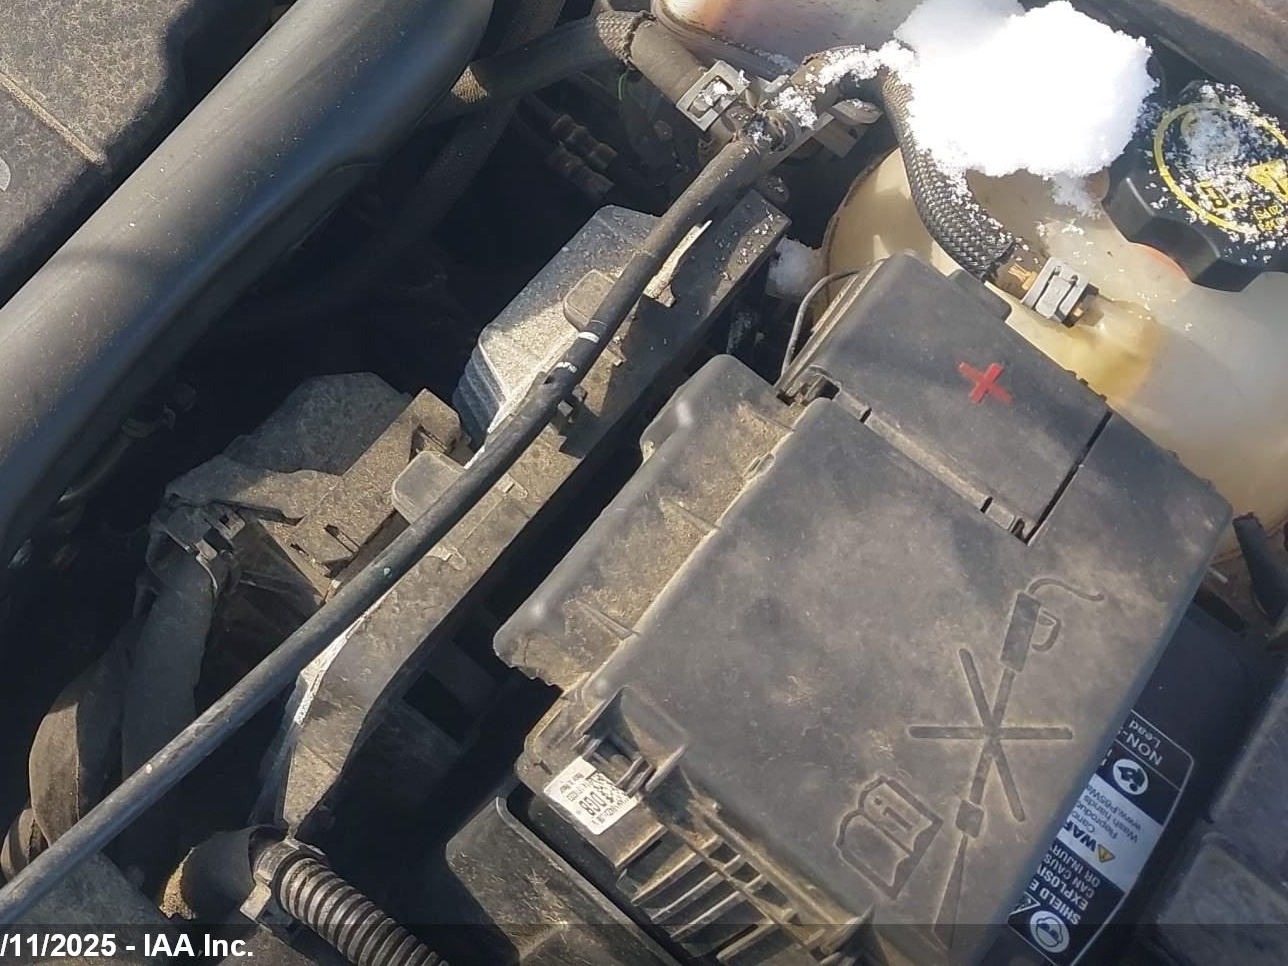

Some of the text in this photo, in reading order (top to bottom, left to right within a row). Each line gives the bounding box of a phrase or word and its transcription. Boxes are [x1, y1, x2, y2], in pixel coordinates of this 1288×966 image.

[1129, 719, 1161, 749] Lead
[1083, 795, 1112, 821] hands
[1072, 877, 1096, 899] CAN
[1083, 872, 1101, 887] OR
[1039, 887, 1082, 925] SHIELD
